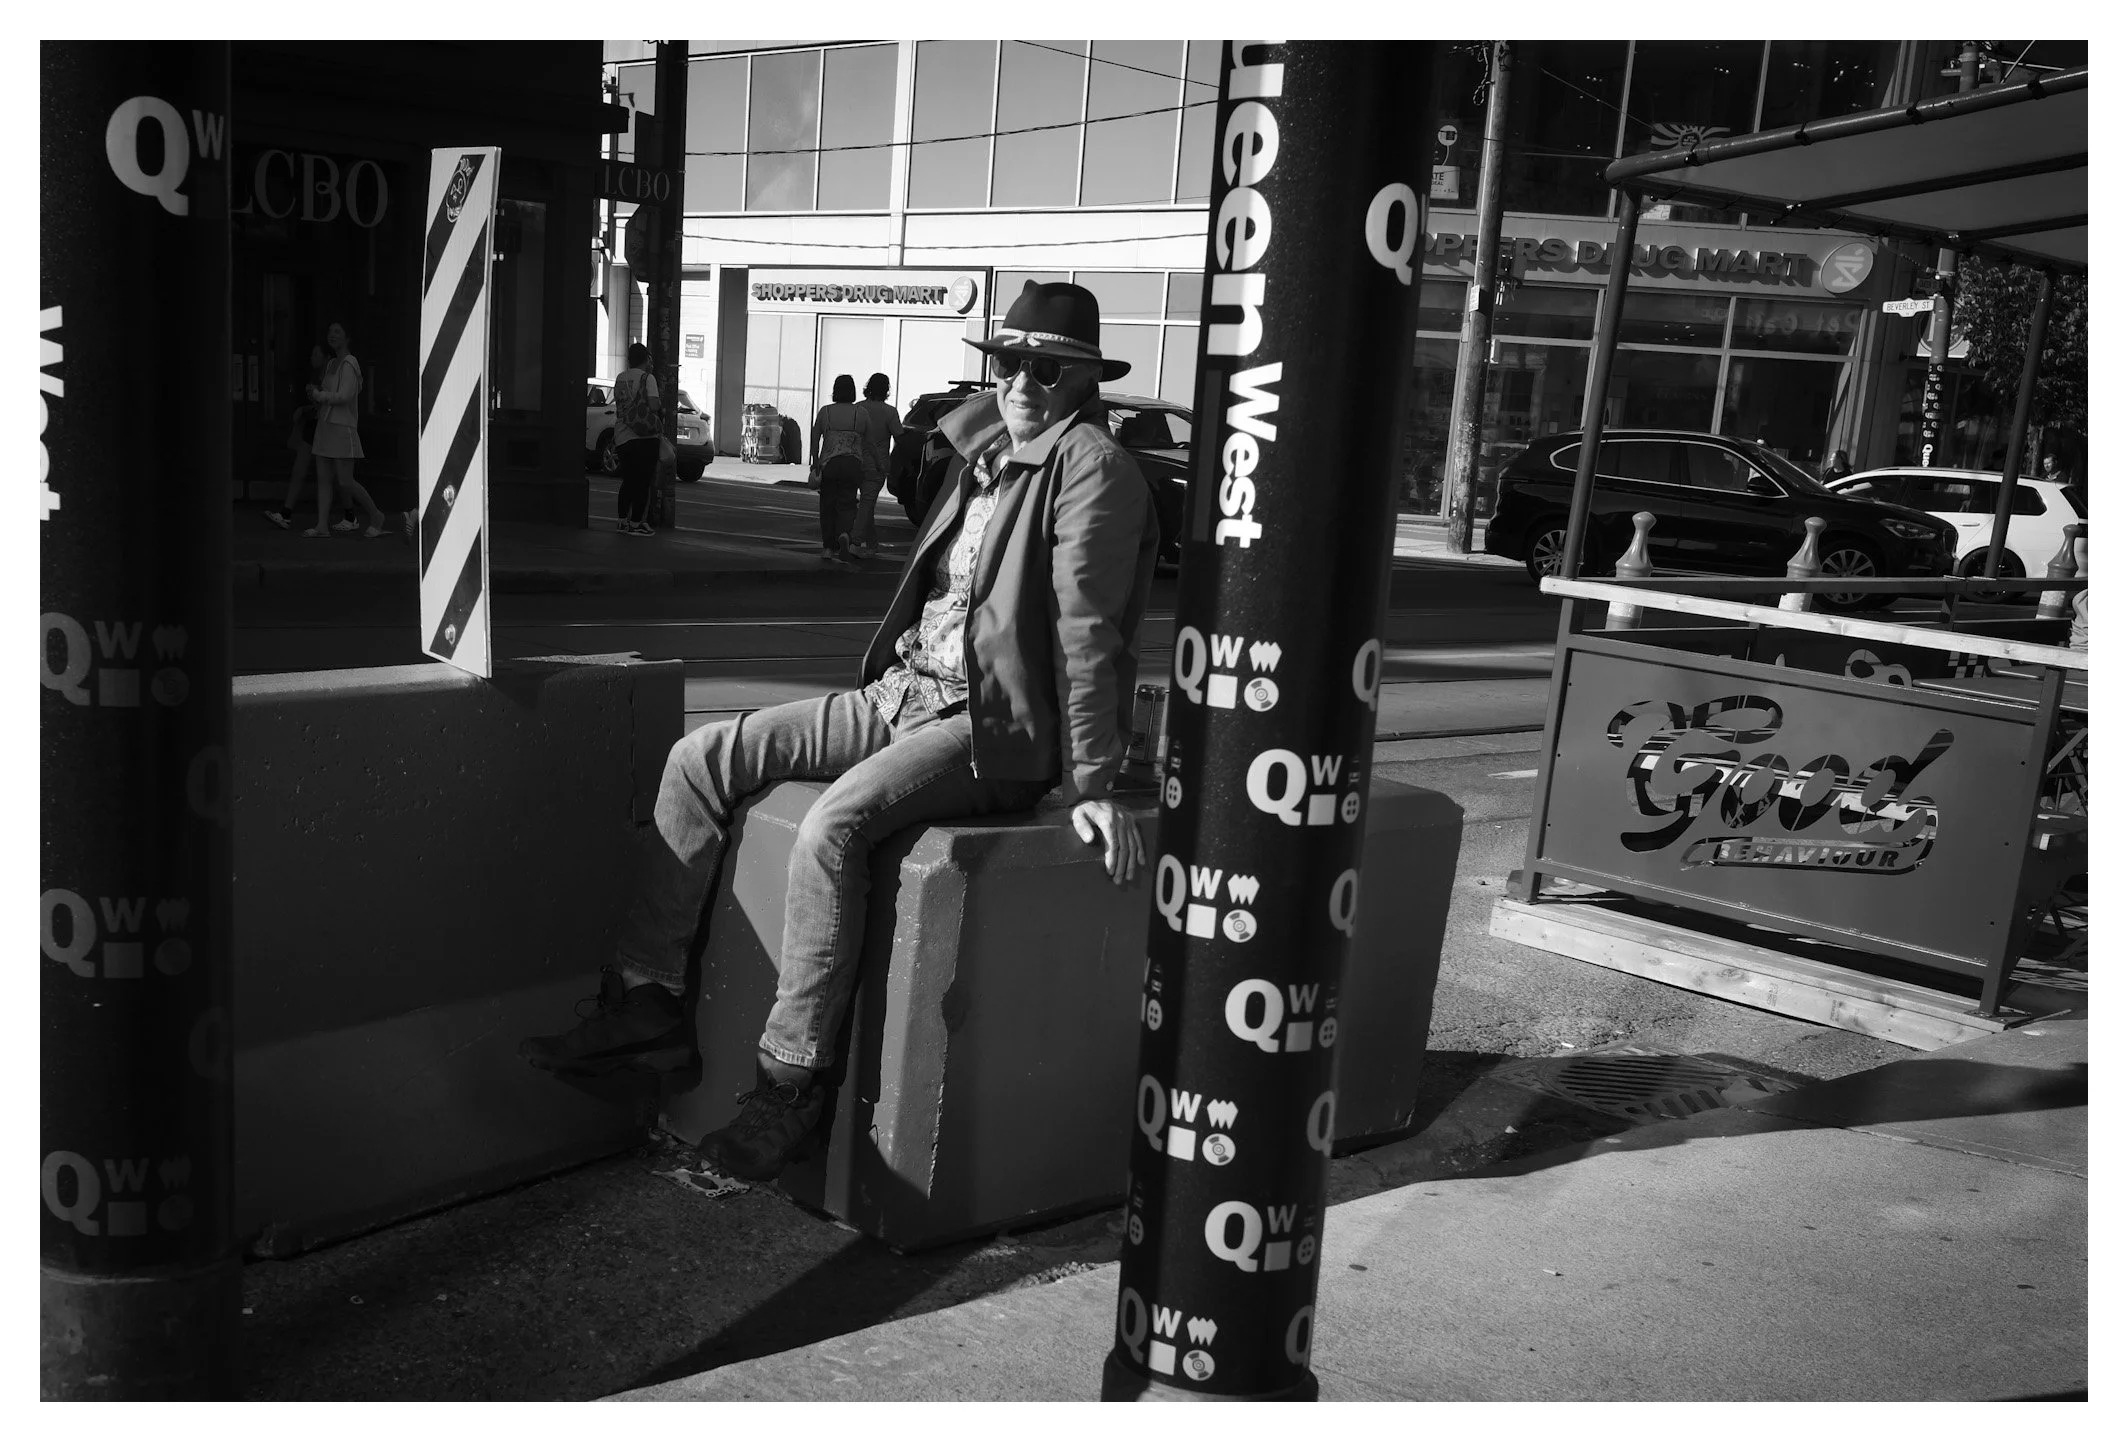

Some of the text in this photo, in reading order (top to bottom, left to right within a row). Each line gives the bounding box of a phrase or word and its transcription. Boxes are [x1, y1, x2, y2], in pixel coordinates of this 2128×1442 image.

[231, 149, 389, 228] CBO
[604, 163, 671, 201] LCBO
[1693, 247, 1807, 277] MART
[751, 282, 946, 304] SHOPPERS DRUG MART
[1886, 301, 1931, 312] BEVERLEY ST
[1215, 361, 1283, 549] West
[1607, 695, 1955, 852] Good
[1713, 842, 1900, 868] BEHAVIOUR
